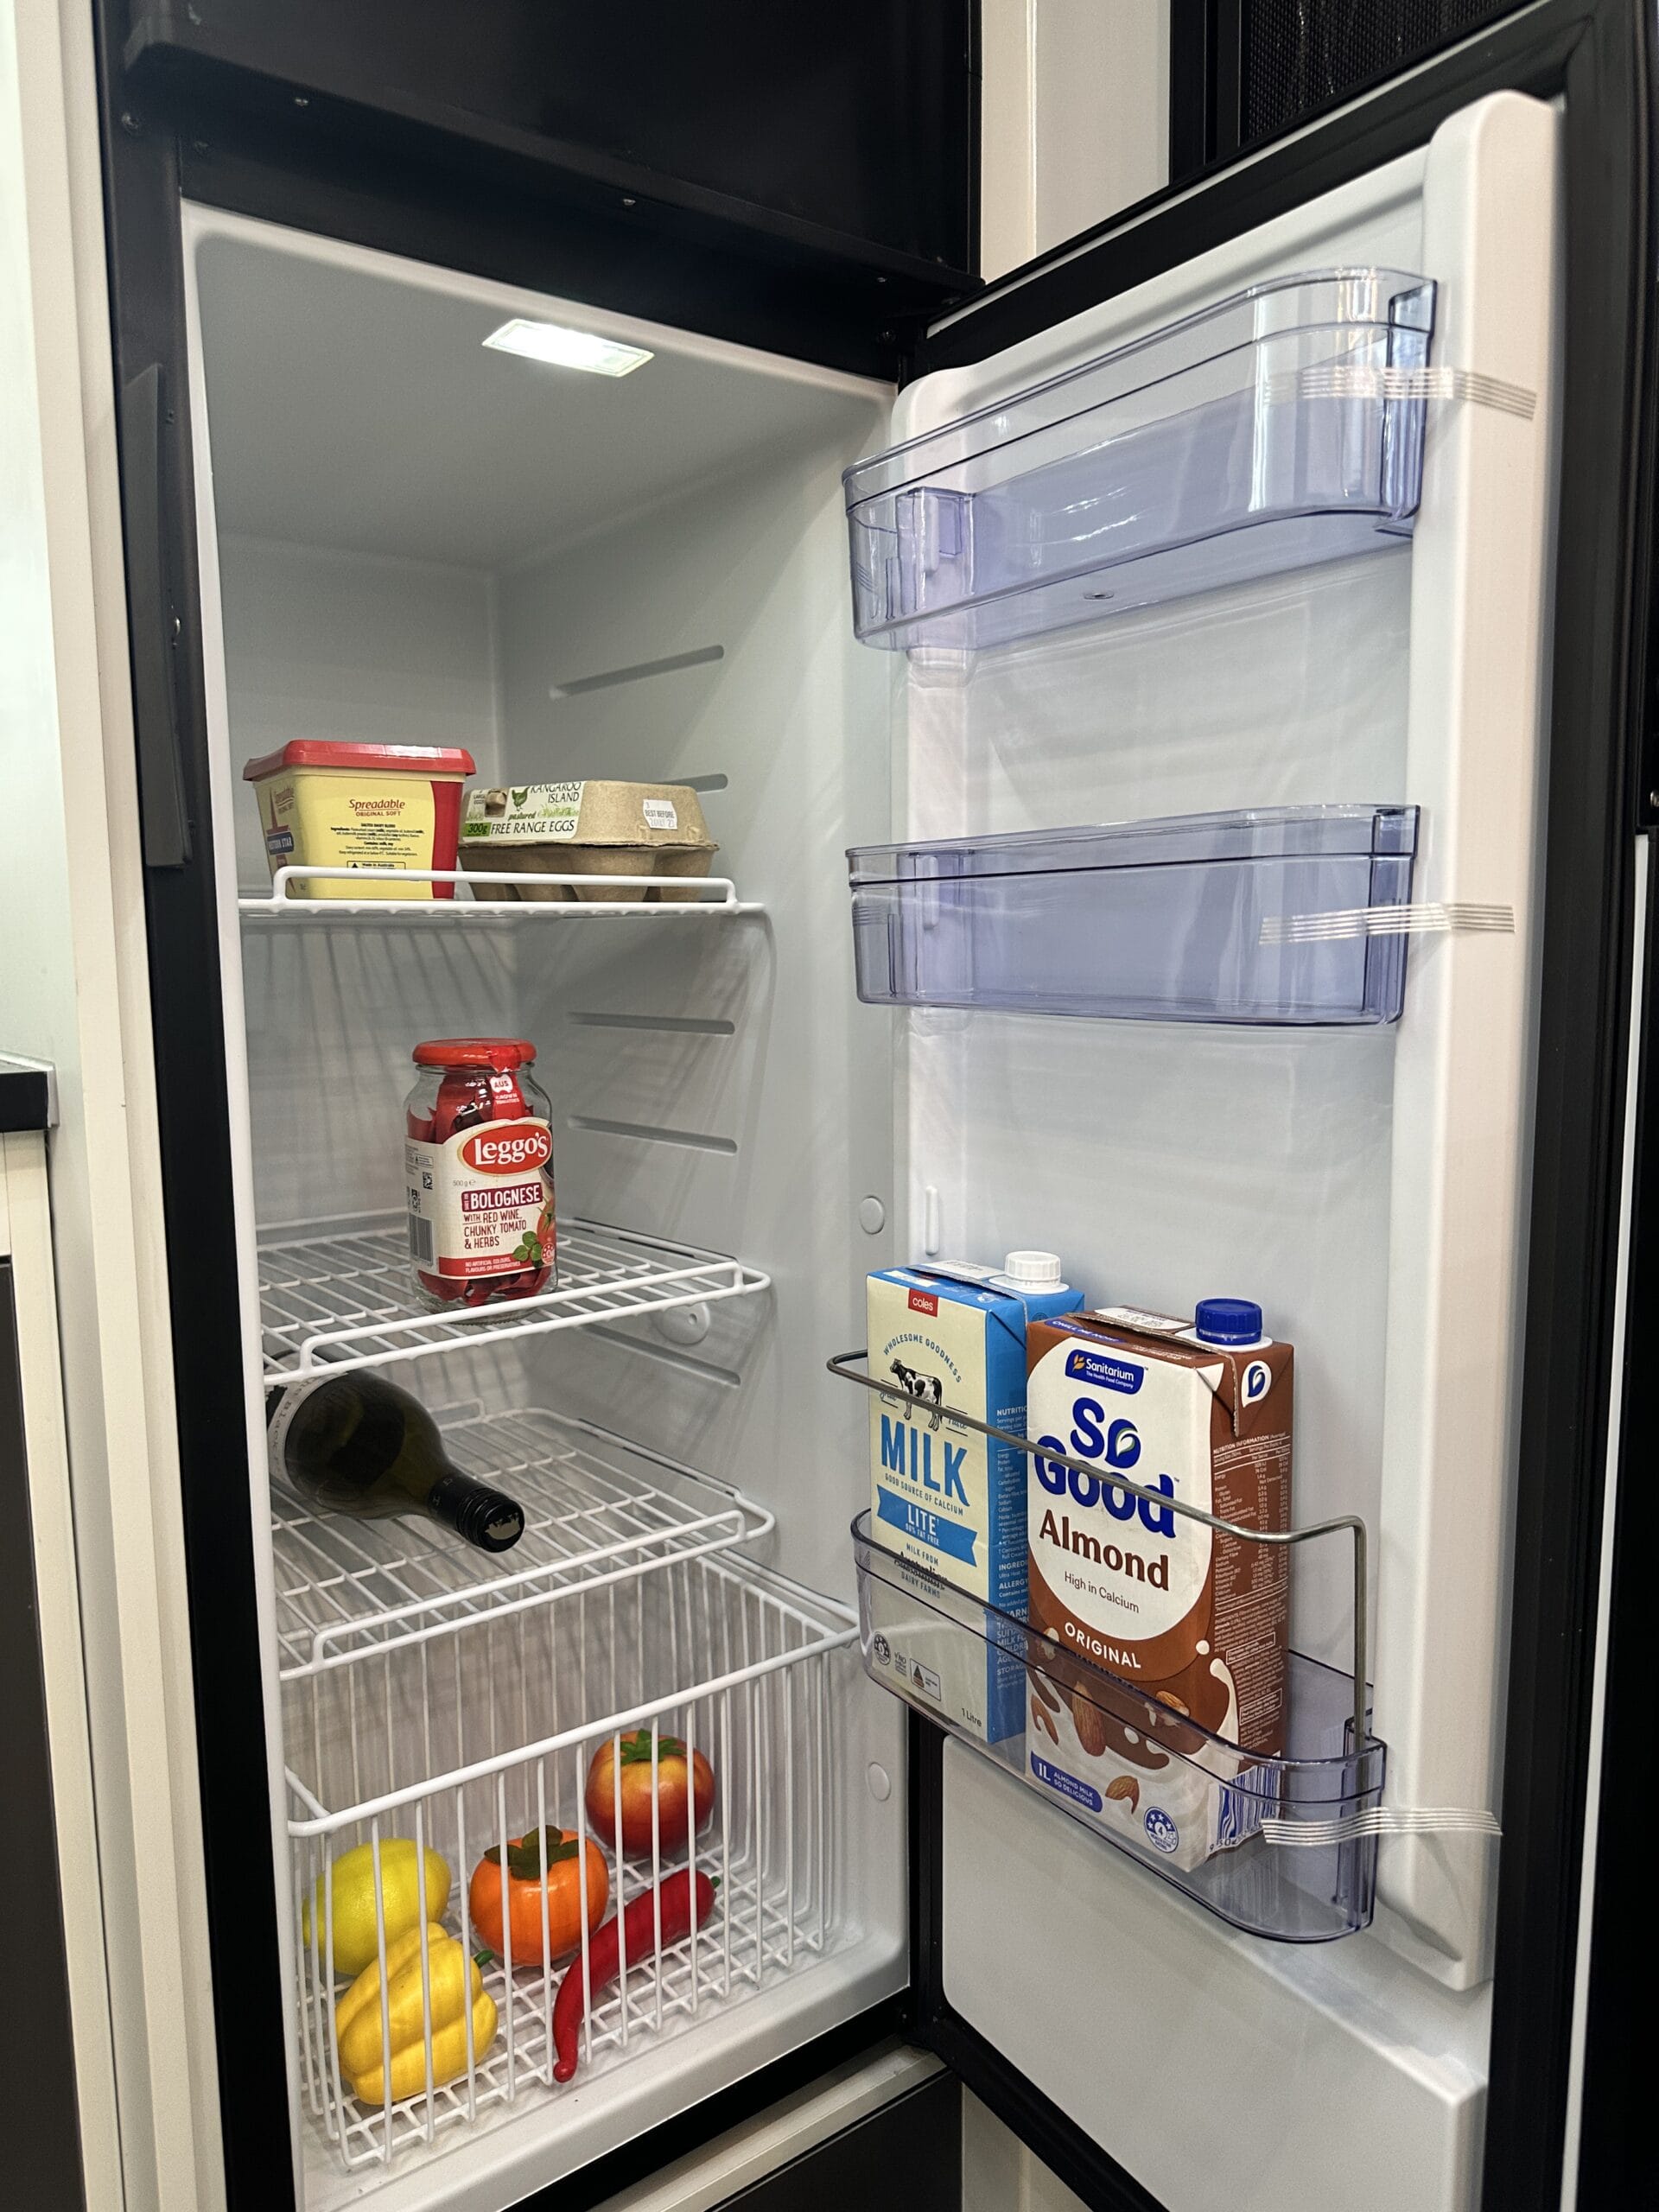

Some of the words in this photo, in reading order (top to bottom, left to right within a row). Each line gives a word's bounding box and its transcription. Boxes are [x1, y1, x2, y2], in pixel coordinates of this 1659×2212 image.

[531, 782, 581, 793] KANGAROO
[548, 791, 579, 803] ISLAND
[349, 798, 405, 811] Spreadable
[491, 823, 511, 835] FREE
[513, 822, 546, 833] RANGE
[550, 820, 575, 832] EGGS
[474, 1132, 548, 1166] Leggo's
[471, 1185, 540, 1210] BOLOGNESE
[463, 1213, 480, 1222] WITH
[483, 1211, 498, 1224] RED
[464, 1224, 497, 1237] CHUNKY
[499, 1220, 527, 1233] TOMATO
[465, 1239, 471, 1249] &
[474, 1236, 499, 1249] HERBS
[912, 1297, 934, 1311] coles
[883, 1333, 923, 1357] WHOLESOME
[925, 1339, 963, 1383] GOODNESS
[1086, 1358, 1135, 1382] Sanitarium
[1116, 1378, 1134, 1389] Company
[1213, 1444, 1236, 1454] NUTRITION
[1236, 1435, 1268, 1447] INFORMATION
[881, 1414, 970, 1507] MILK
[885, 1473, 899, 1487] GOOD
[901, 1479, 923, 1498] SOURCE
[925, 1492, 932, 1502] OF
[934, 1497, 963, 1516] CALCIUM
[1034, 1435, 1176, 1538] Good
[917, 1529, 925, 1540] FAT
[928, 1534, 940, 1547] FREE
[906, 1543, 920, 1555] MILK
[922, 1551, 938, 1566] FROM
[1039, 1509, 1169, 1592] Almond
[901, 1571, 918, 1588] DAIRY
[920, 1580, 940, 1599] FARMS
[1065, 1571, 1086, 1590] High
[1088, 1580, 1096, 1595] in
[1099, 1586, 1140, 1614] Calcium
[1065, 1622, 1141, 1669] ORIGINAL
[966, 1710, 982, 1727] Litre
[1038, 1762, 1051, 1782] 1L
[1053, 1771, 1078, 1790] ALMOND
[1079, 1784, 1094, 1799] MILK
[1054, 1778, 1063, 1789] SO
[1063, 1783, 1093, 1806] DELICIOUS
[1157, 1826, 1164, 1836] 4
